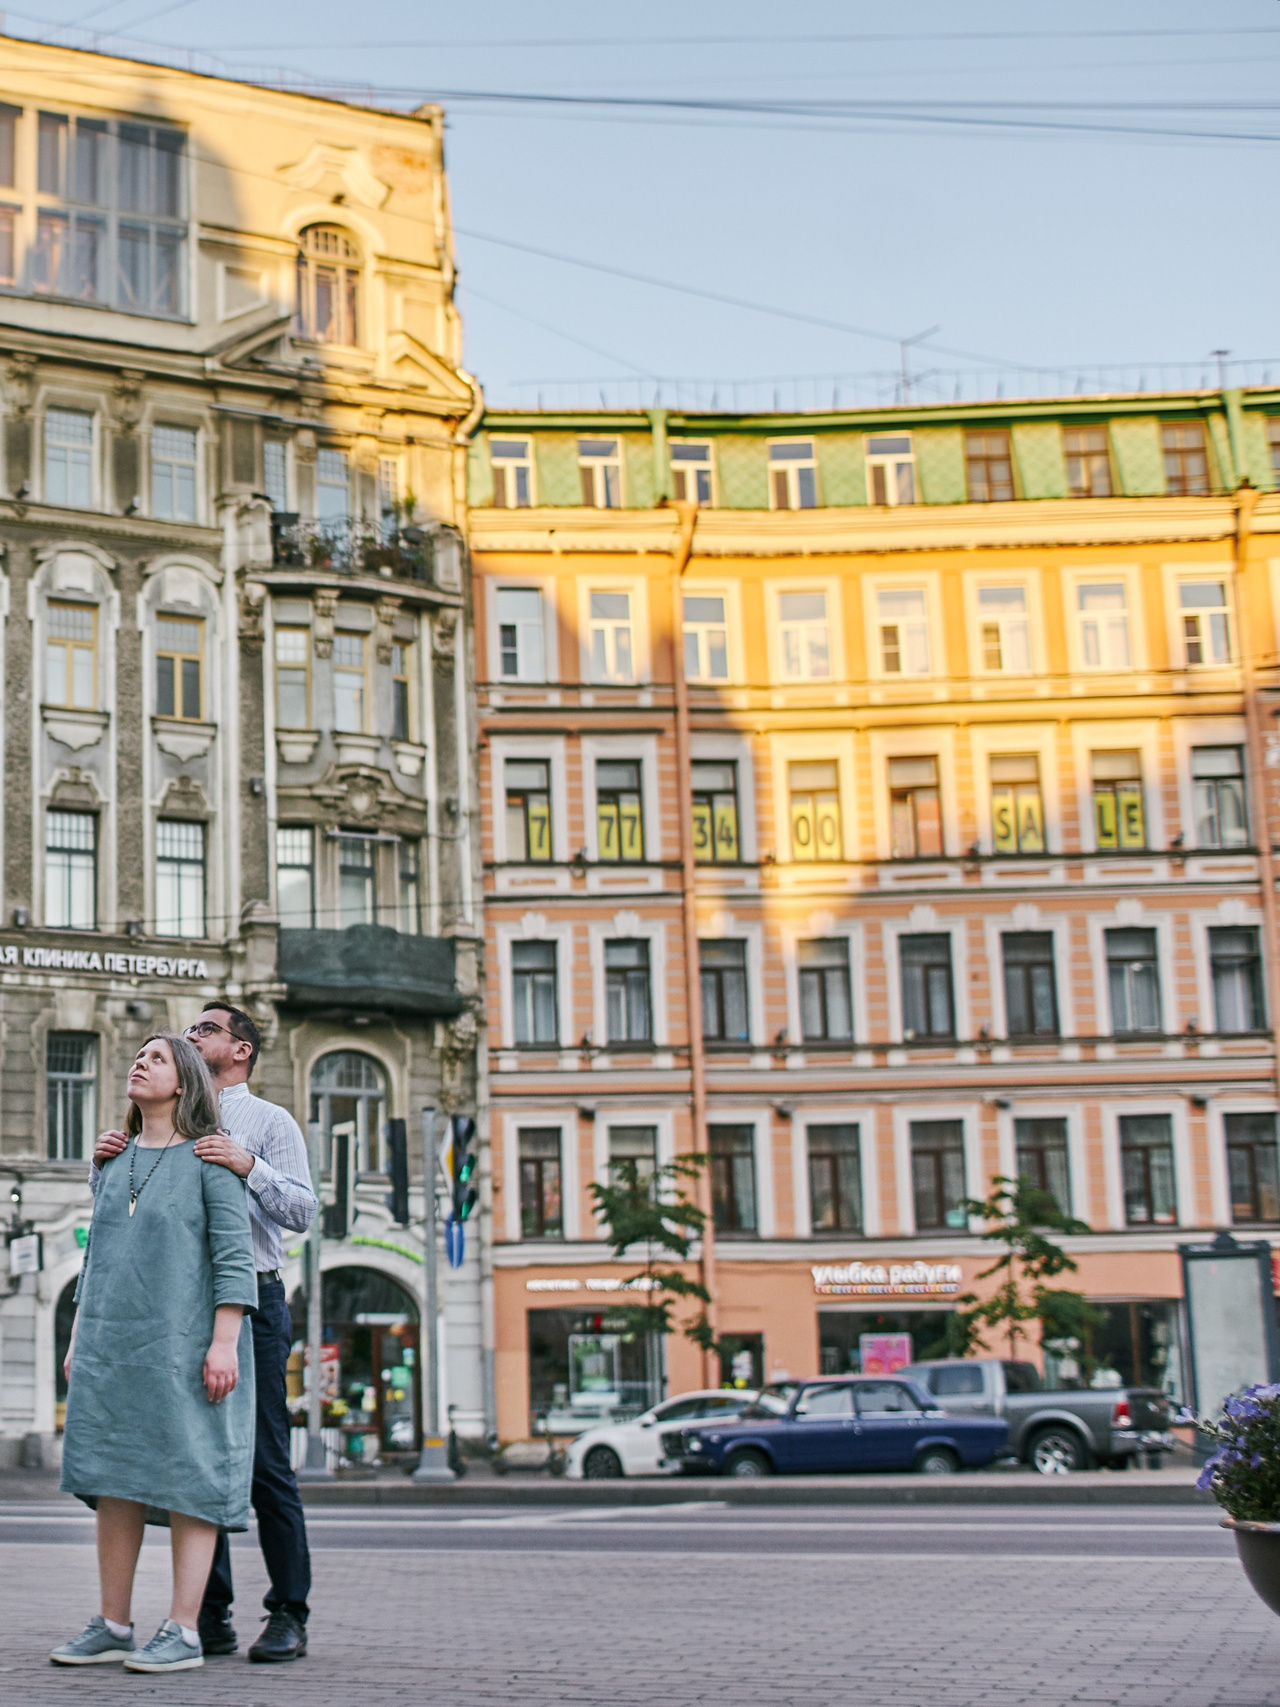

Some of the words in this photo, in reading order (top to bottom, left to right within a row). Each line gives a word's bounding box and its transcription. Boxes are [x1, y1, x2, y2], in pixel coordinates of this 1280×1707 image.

[694, 816, 734, 848] 34
[23, 946, 103, 971] КЛИНИКА
[104, 952, 209, 979] ПЕТЕРБУРГА
